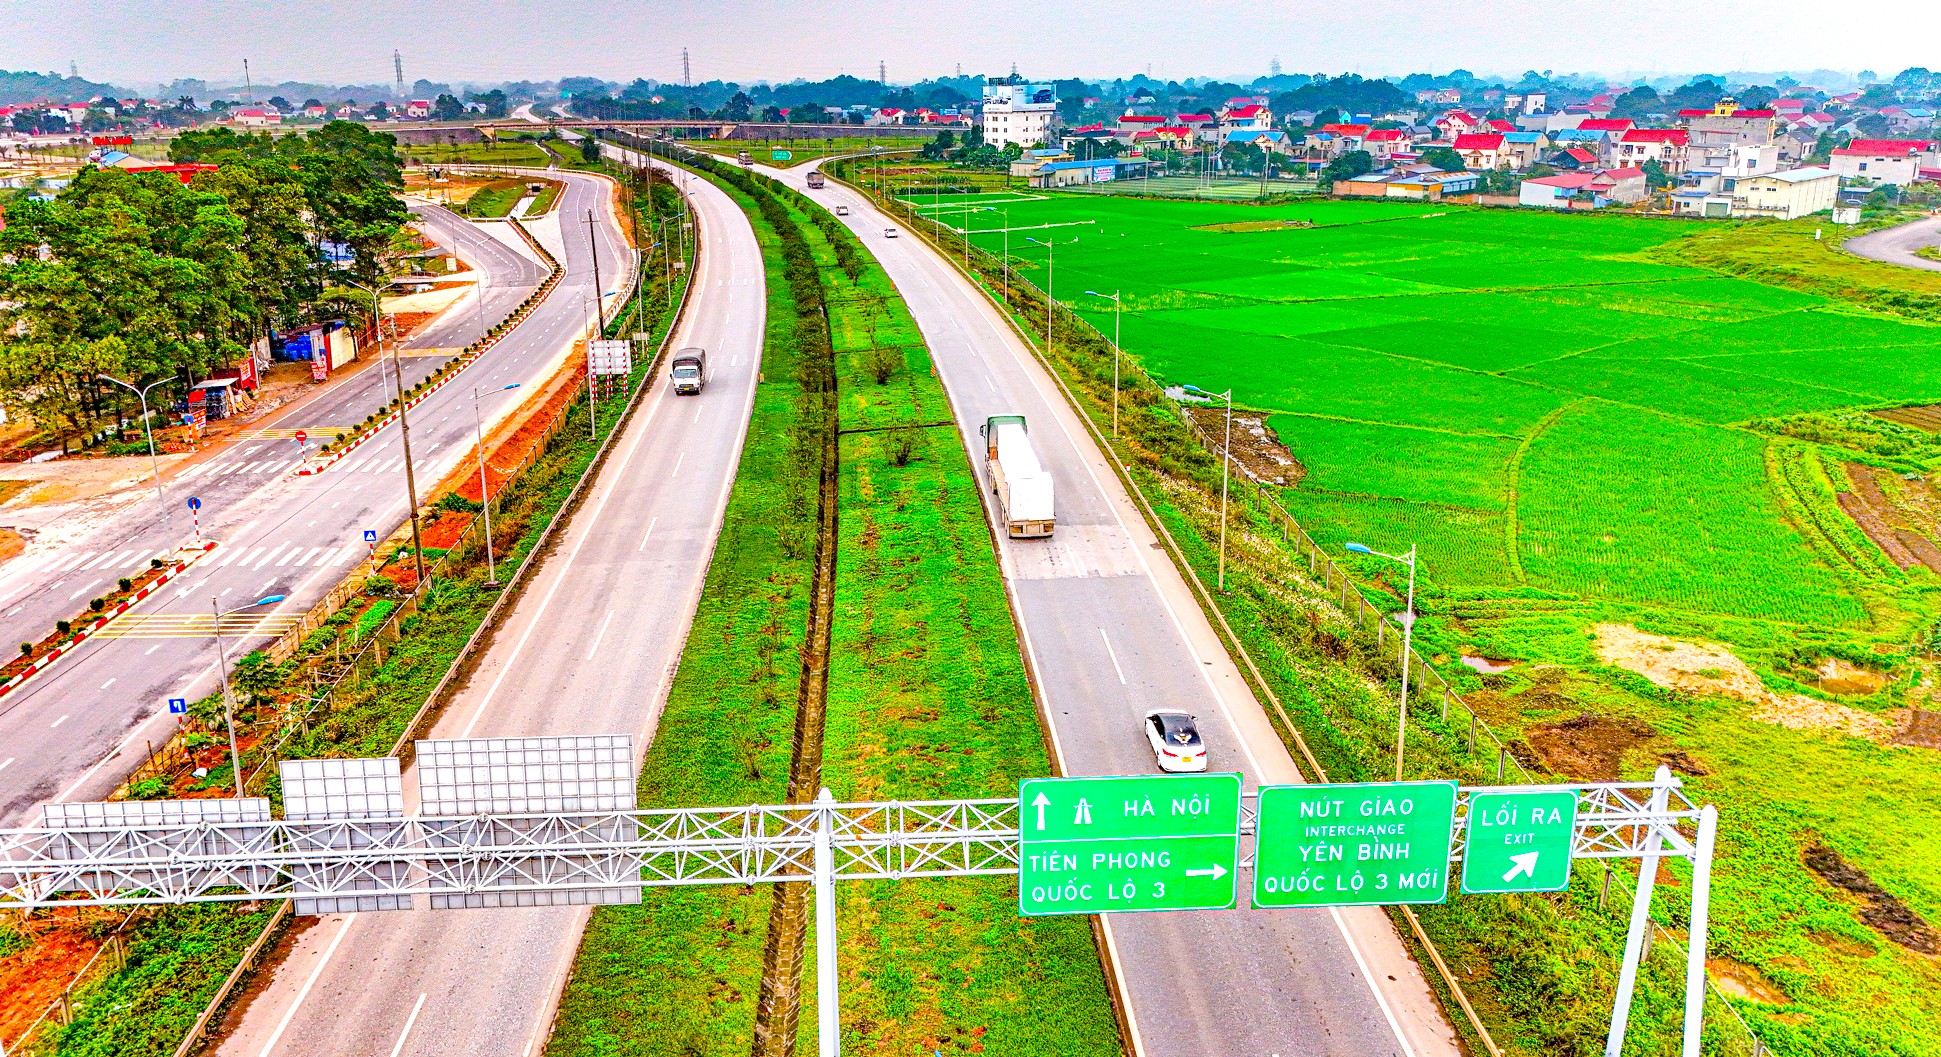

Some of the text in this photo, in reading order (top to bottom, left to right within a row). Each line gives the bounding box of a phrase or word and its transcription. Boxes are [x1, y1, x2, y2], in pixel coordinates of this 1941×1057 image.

[1124, 795, 1155, 816] HÀ
[1300, 796, 1344, 818] NÚT
[1531, 808, 1562, 825] RA
[1305, 824, 1406, 837] INTERCHANGE
[1504, 832, 1535, 845] EXIT
[1298, 836, 1410, 862] YÊN BÌNH
[1092, 852, 1171, 870] PHONG
[1032, 876, 1165, 904] QUỐC LỘ 3
[1264, 868, 1325, 893] QUỐC
[1336, 870, 1364, 894] LỘ
[1375, 874, 1389, 890] 3
